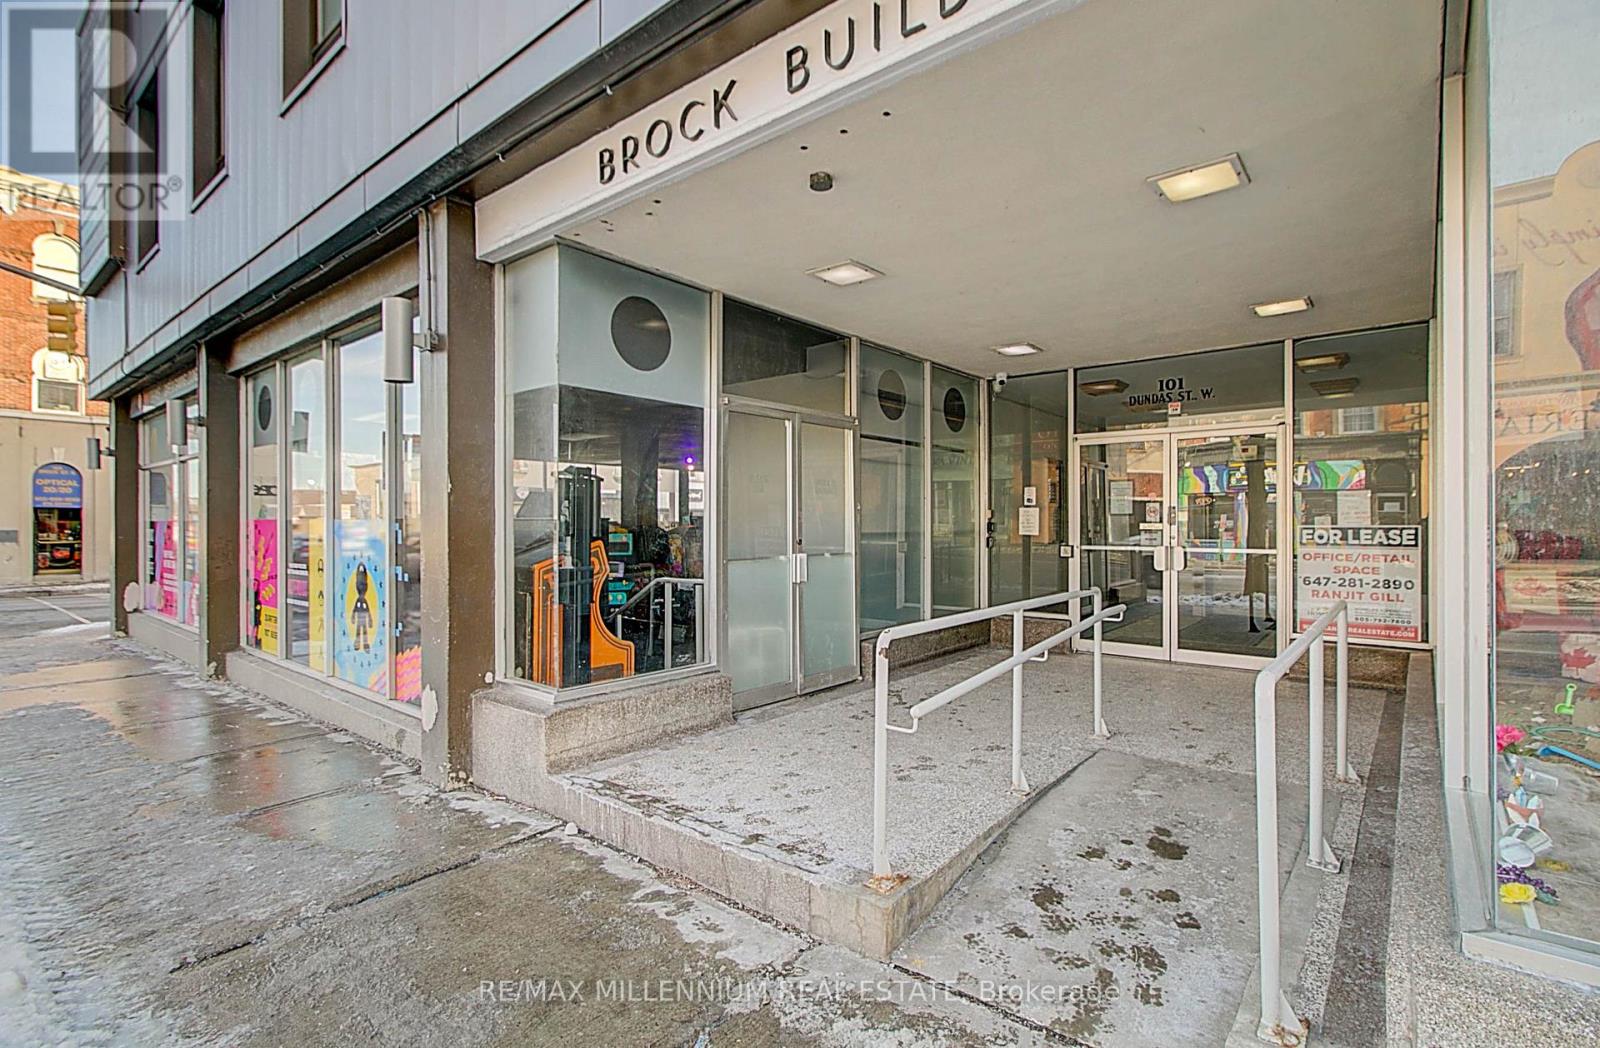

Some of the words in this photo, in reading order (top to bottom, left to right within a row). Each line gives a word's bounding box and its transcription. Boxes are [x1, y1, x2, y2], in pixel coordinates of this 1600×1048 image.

[599, 79, 738, 185] BROCK
[1158, 378, 1185, 392] 101
[1129, 391, 1173, 406] DUNDAS
[1201, 387, 1215, 400] W.
[35, 479, 80, 487] OPTICAL
[1301, 528, 1343, 545] FOR
[1347, 528, 1416, 546] LEASE
[1302, 552, 1415, 564] OFFICE/RETAIL
[1333, 565, 1382, 576] SPACE
[1302, 576, 1415, 591] 647-281-2890
[1311, 589, 1365, 601] RANJIT
[1370, 592, 1405, 603] GILL
